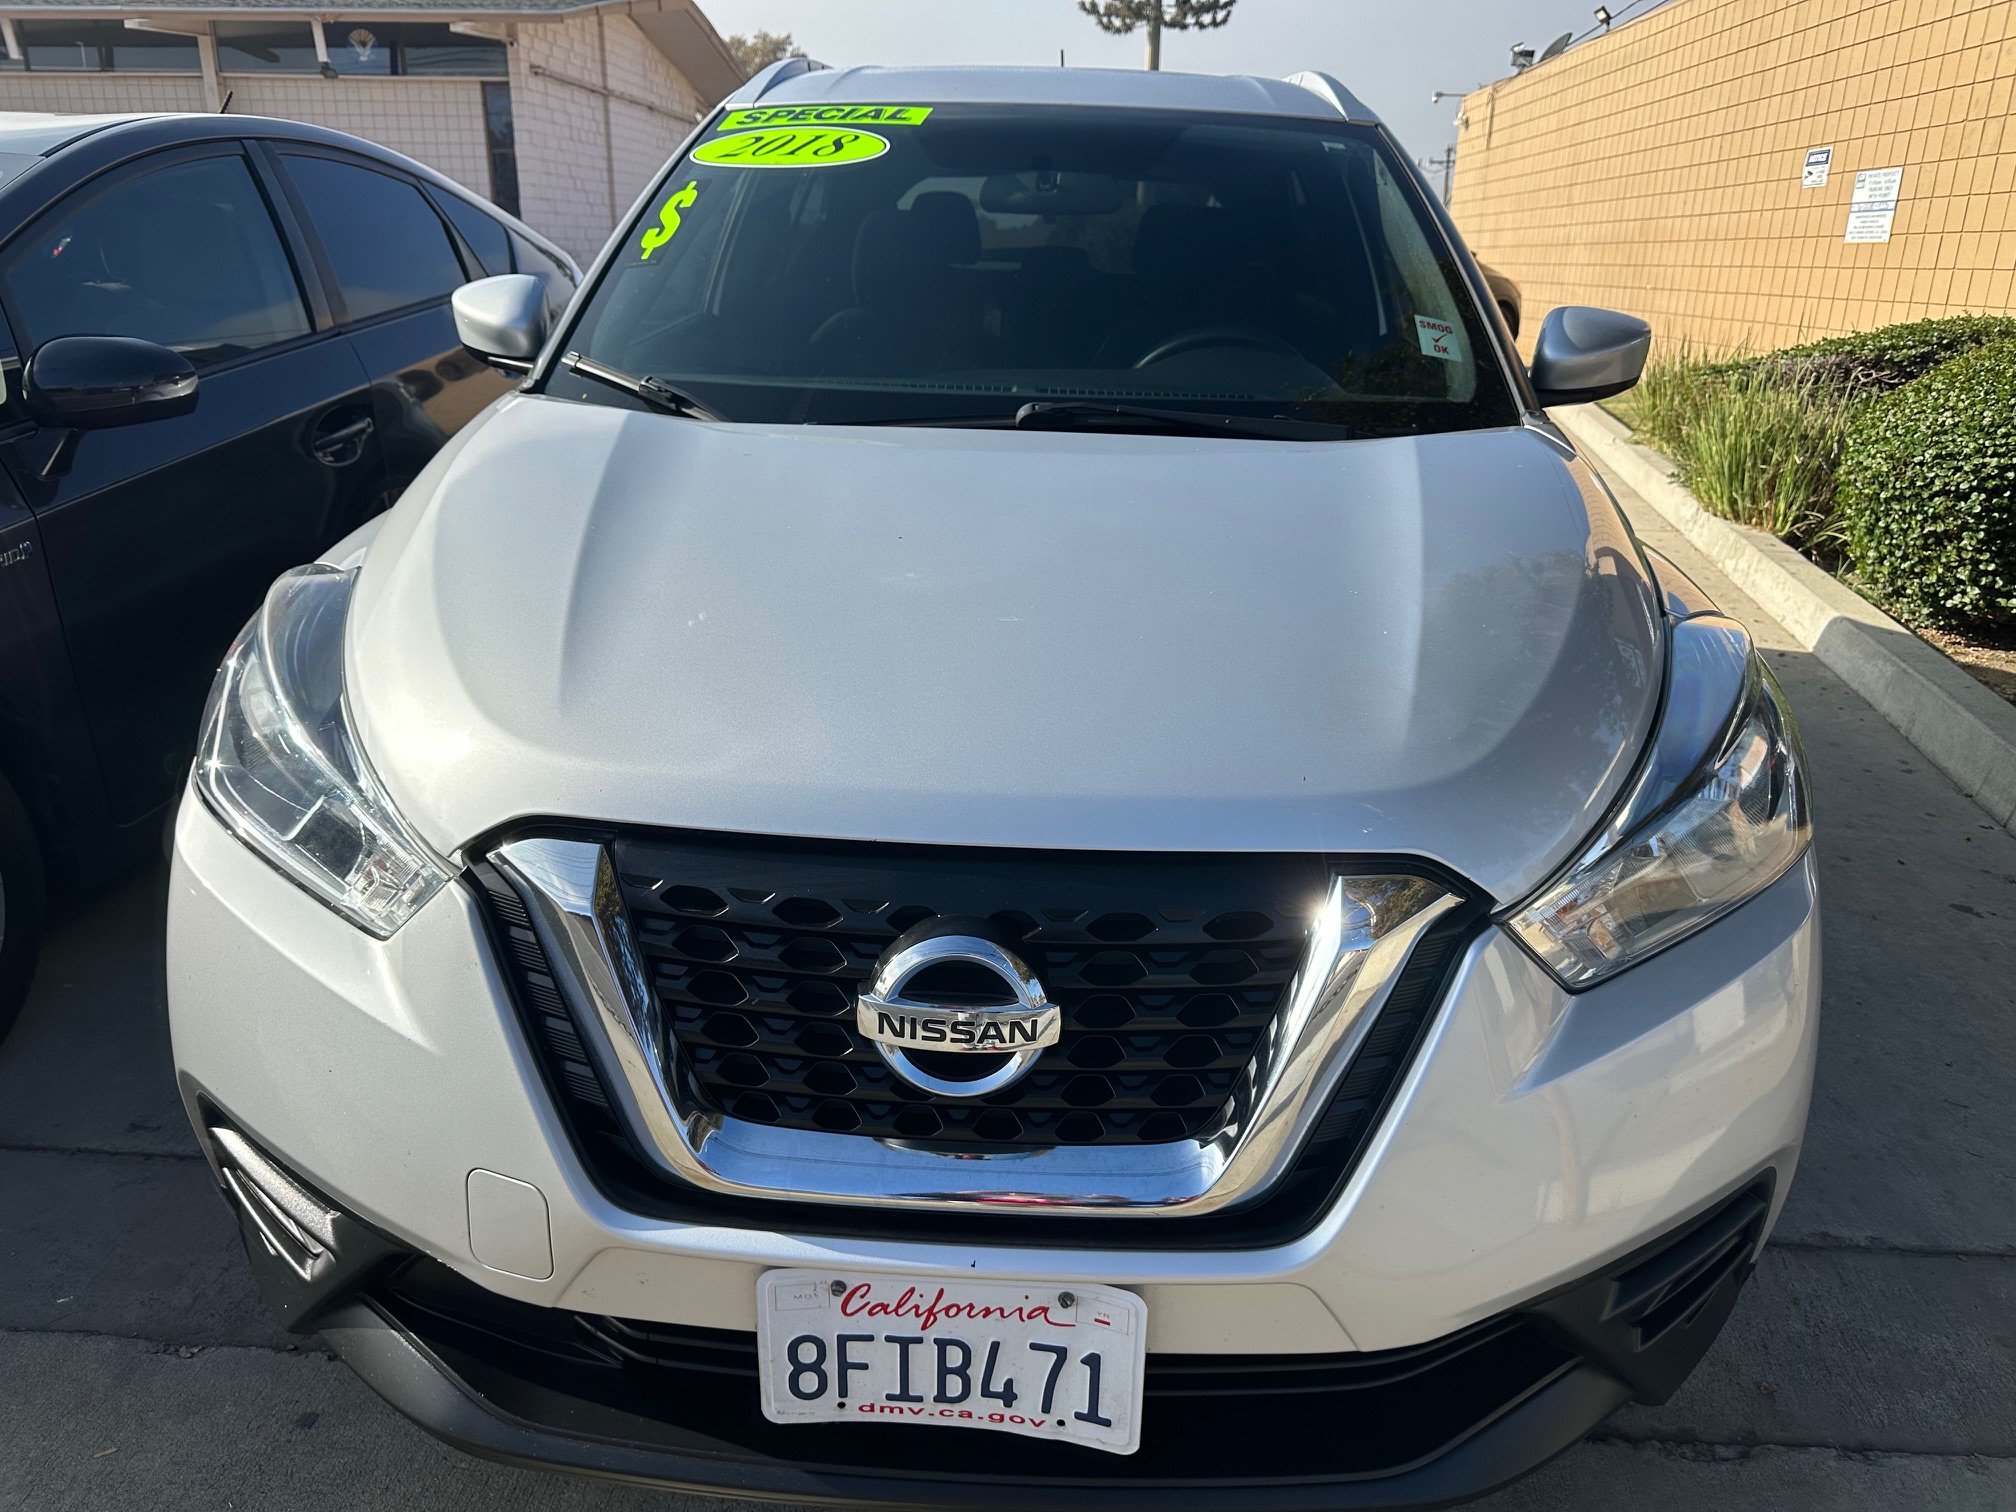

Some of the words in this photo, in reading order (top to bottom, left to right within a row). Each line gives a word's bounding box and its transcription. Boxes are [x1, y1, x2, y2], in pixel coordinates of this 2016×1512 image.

[736, 107, 912, 126] SPECIAL
[715, 133, 860, 159] 2018
[641, 180, 698, 260] $
[1419, 320, 1453, 334] SMOG
[1433, 344, 1450, 355] OK
[877, 1011, 1038, 1044] NISSAN
[840, 1282, 1076, 1331] California
[787, 1333, 1112, 1427] 8FIB471
[858, 1402, 1046, 1428] dmv.ca.gov
